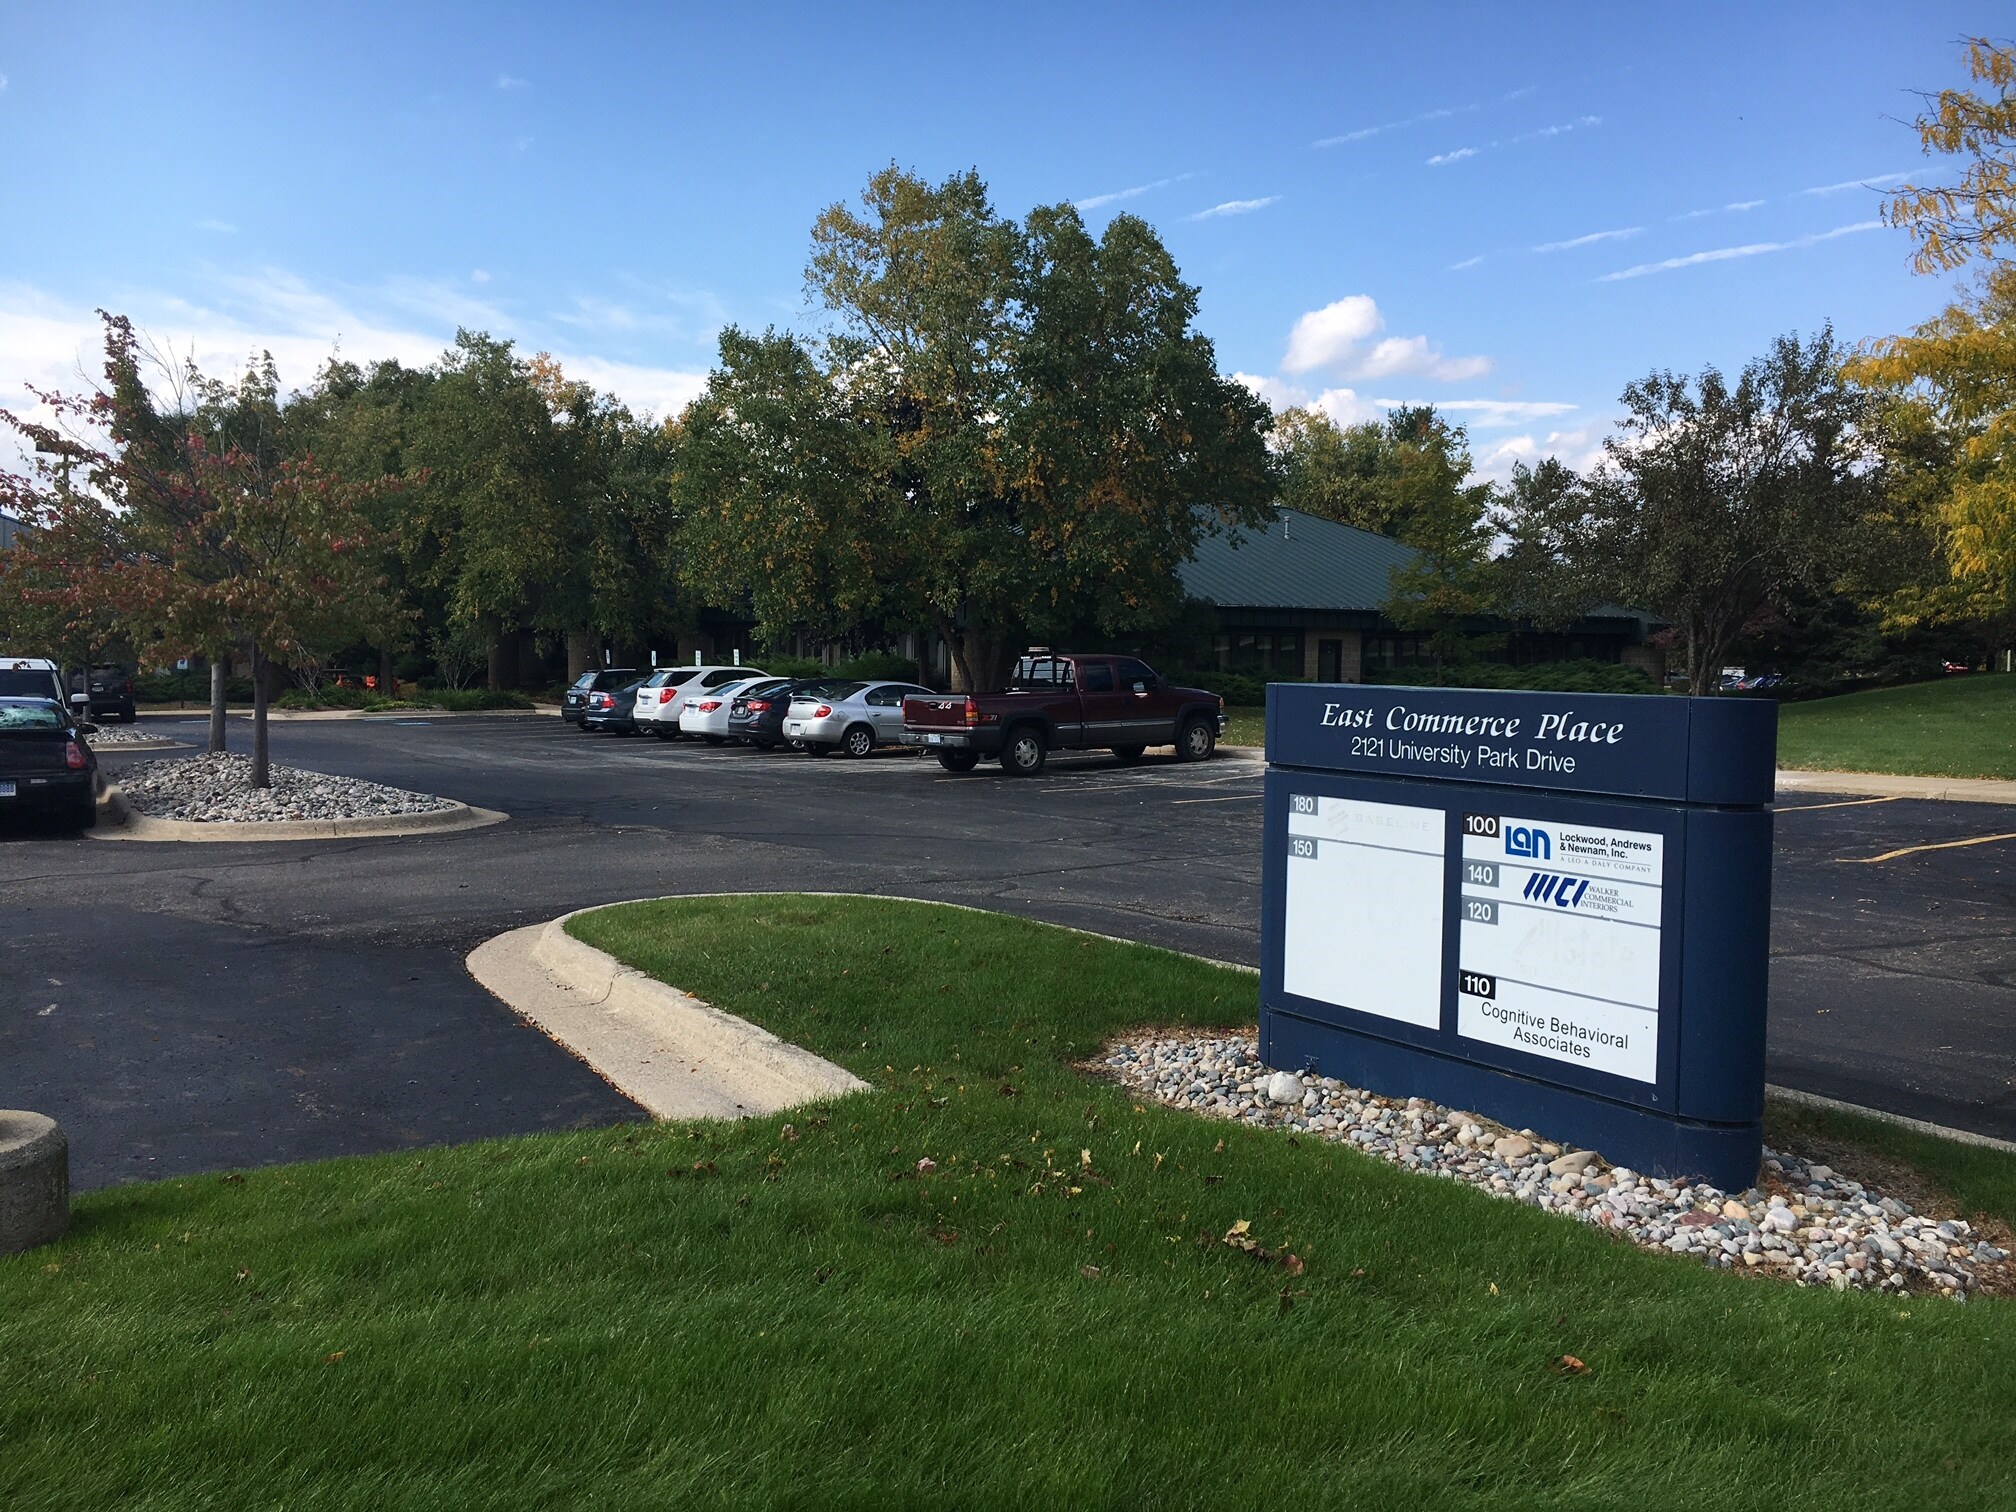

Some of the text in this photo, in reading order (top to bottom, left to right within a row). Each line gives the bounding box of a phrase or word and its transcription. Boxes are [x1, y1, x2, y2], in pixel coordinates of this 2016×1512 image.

[1320, 703, 1624, 744] East Commerce Place
[1351, 736, 1576, 773] 2121 University Park Drive
[1294, 797, 1313, 812] 180
[1466, 816, 1497, 835] 100
[1293, 840, 1312, 856] 150
[1560, 832, 1652, 851] Lockwood, Andrews
[1560, 842, 1628, 859] & Newnam, Inc.
[1468, 865, 1493, 883] 140
[1614, 863, 1652, 873] COMPANY
[1584, 893, 1634, 907] COMMERCIAL
[1589, 886, 1619, 897] WALKER
[1468, 902, 1491, 920] 120
[1581, 900, 1618, 913] INTERIORS
[1465, 975, 1490, 995] 110
[1481, 1001, 1628, 1049] Cognitive Behavioral
[1513, 1026, 1590, 1058] Associates
